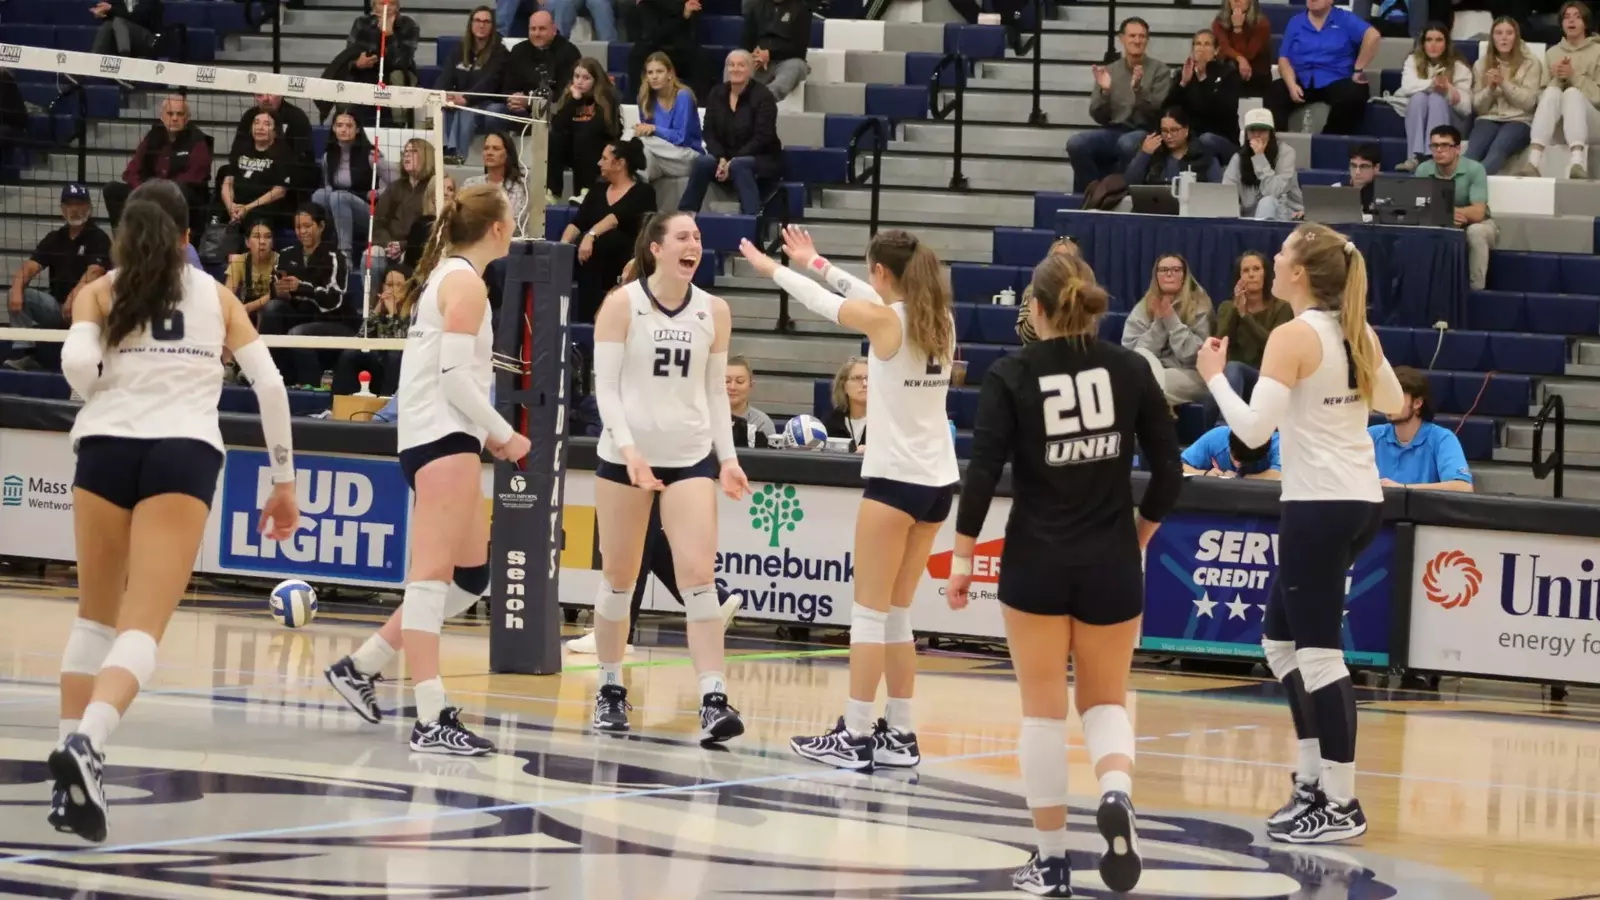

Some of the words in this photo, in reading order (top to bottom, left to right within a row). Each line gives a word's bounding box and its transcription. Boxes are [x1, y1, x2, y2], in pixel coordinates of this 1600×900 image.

[654, 329, 692, 343] UNH
[653, 347, 691, 378] 24
[904, 379, 922, 388] NEW
[1038, 367, 1115, 436] 20
[1323, 397, 1343, 405] NEW
[549, 295, 570, 580] WILDCATS
[1046, 433, 1120, 464] UNH
[28, 476, 68, 495] Mass
[28, 498, 74, 511] Wentwor
[230, 511, 395, 568] LIGHT
[714, 547, 855, 583] ennebunk
[1192, 566, 1270, 590] CREDIT
[980, 590, 998, 600] Res
[1499, 551, 1600, 621] Uni
[1498, 631, 1575, 658] energy
